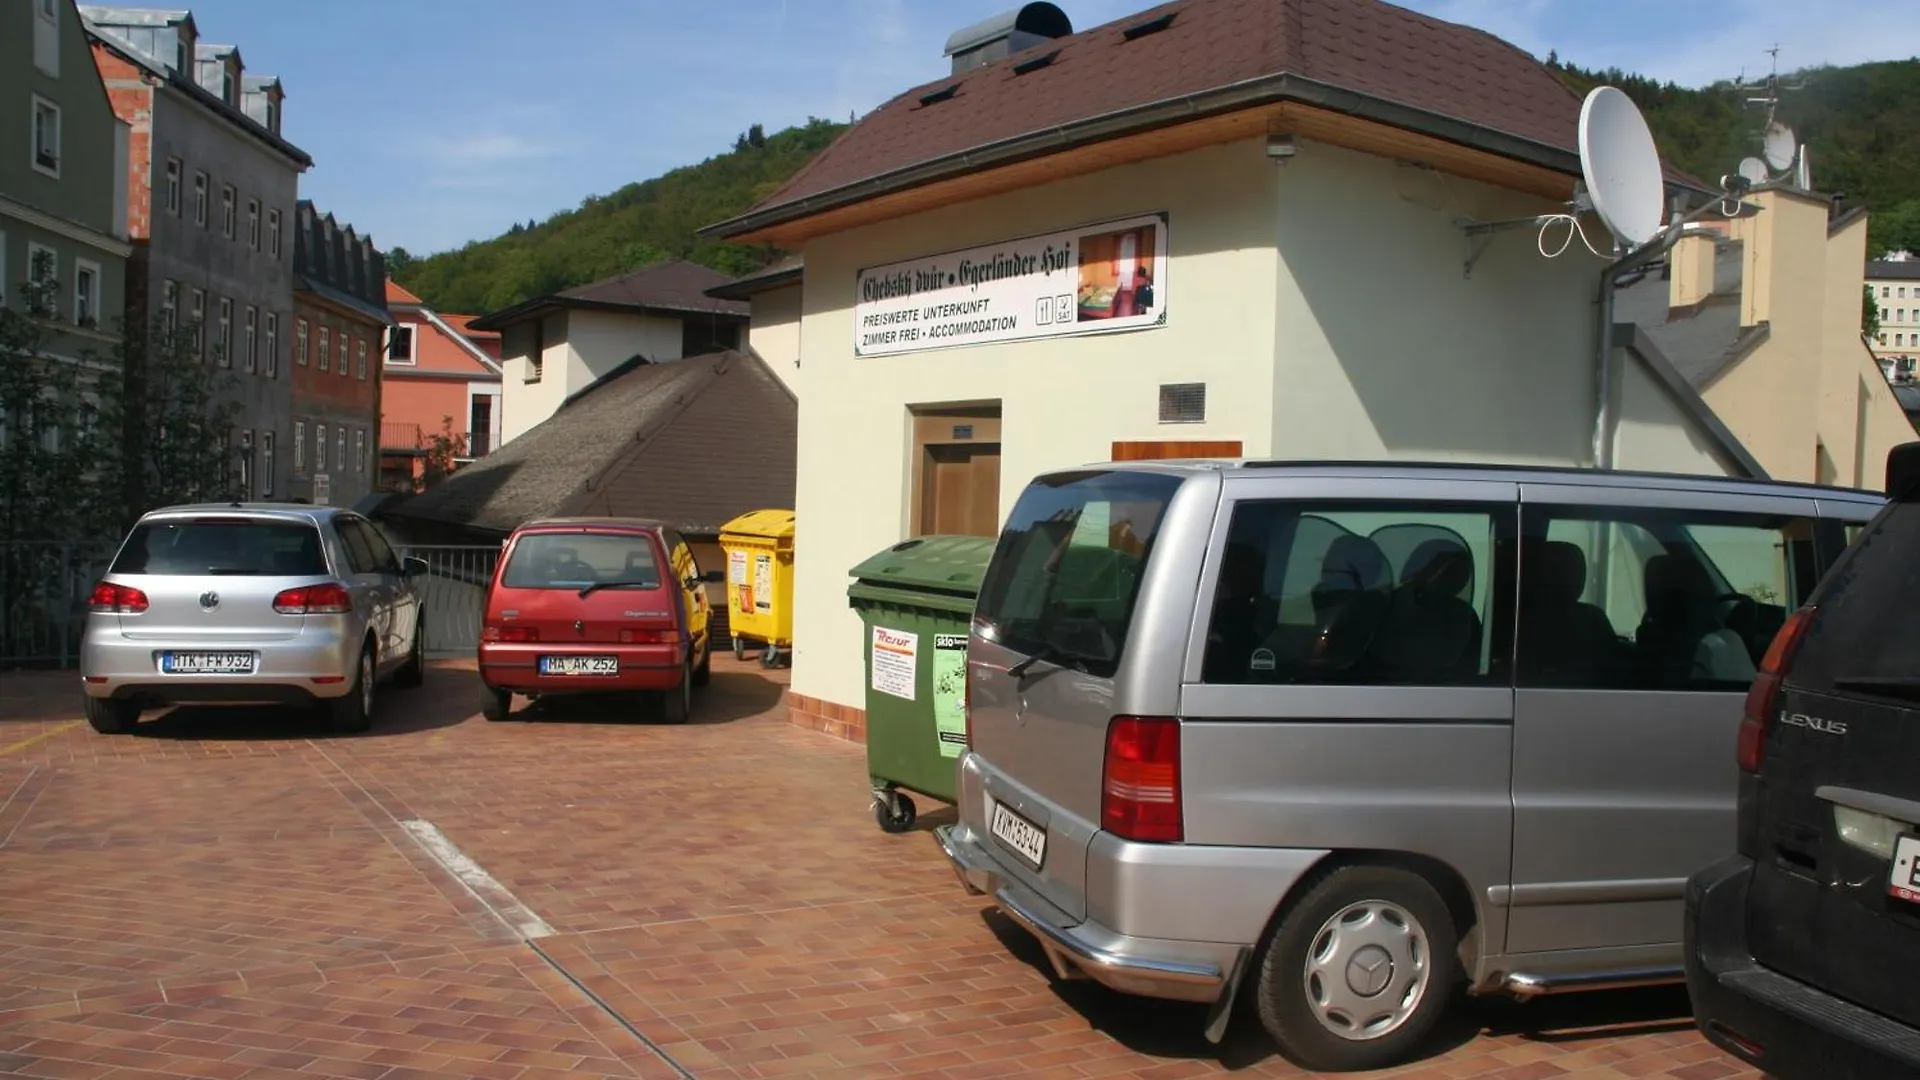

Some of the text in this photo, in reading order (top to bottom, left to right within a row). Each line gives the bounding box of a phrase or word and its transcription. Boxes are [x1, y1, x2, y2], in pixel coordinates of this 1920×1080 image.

[863, 270, 912, 304] Chebský
[916, 265, 944, 292] dvůr
[959, 252, 1036, 292] Egerländer
[863, 299, 990, 327] PREISWERTE UNTERKUNFT
[863, 315, 1017, 346] ZIMMER FREI ACCOMMODATION
[549, 658, 616, 670] MA AK 252
[1780, 710, 1848, 735] LEXUS
